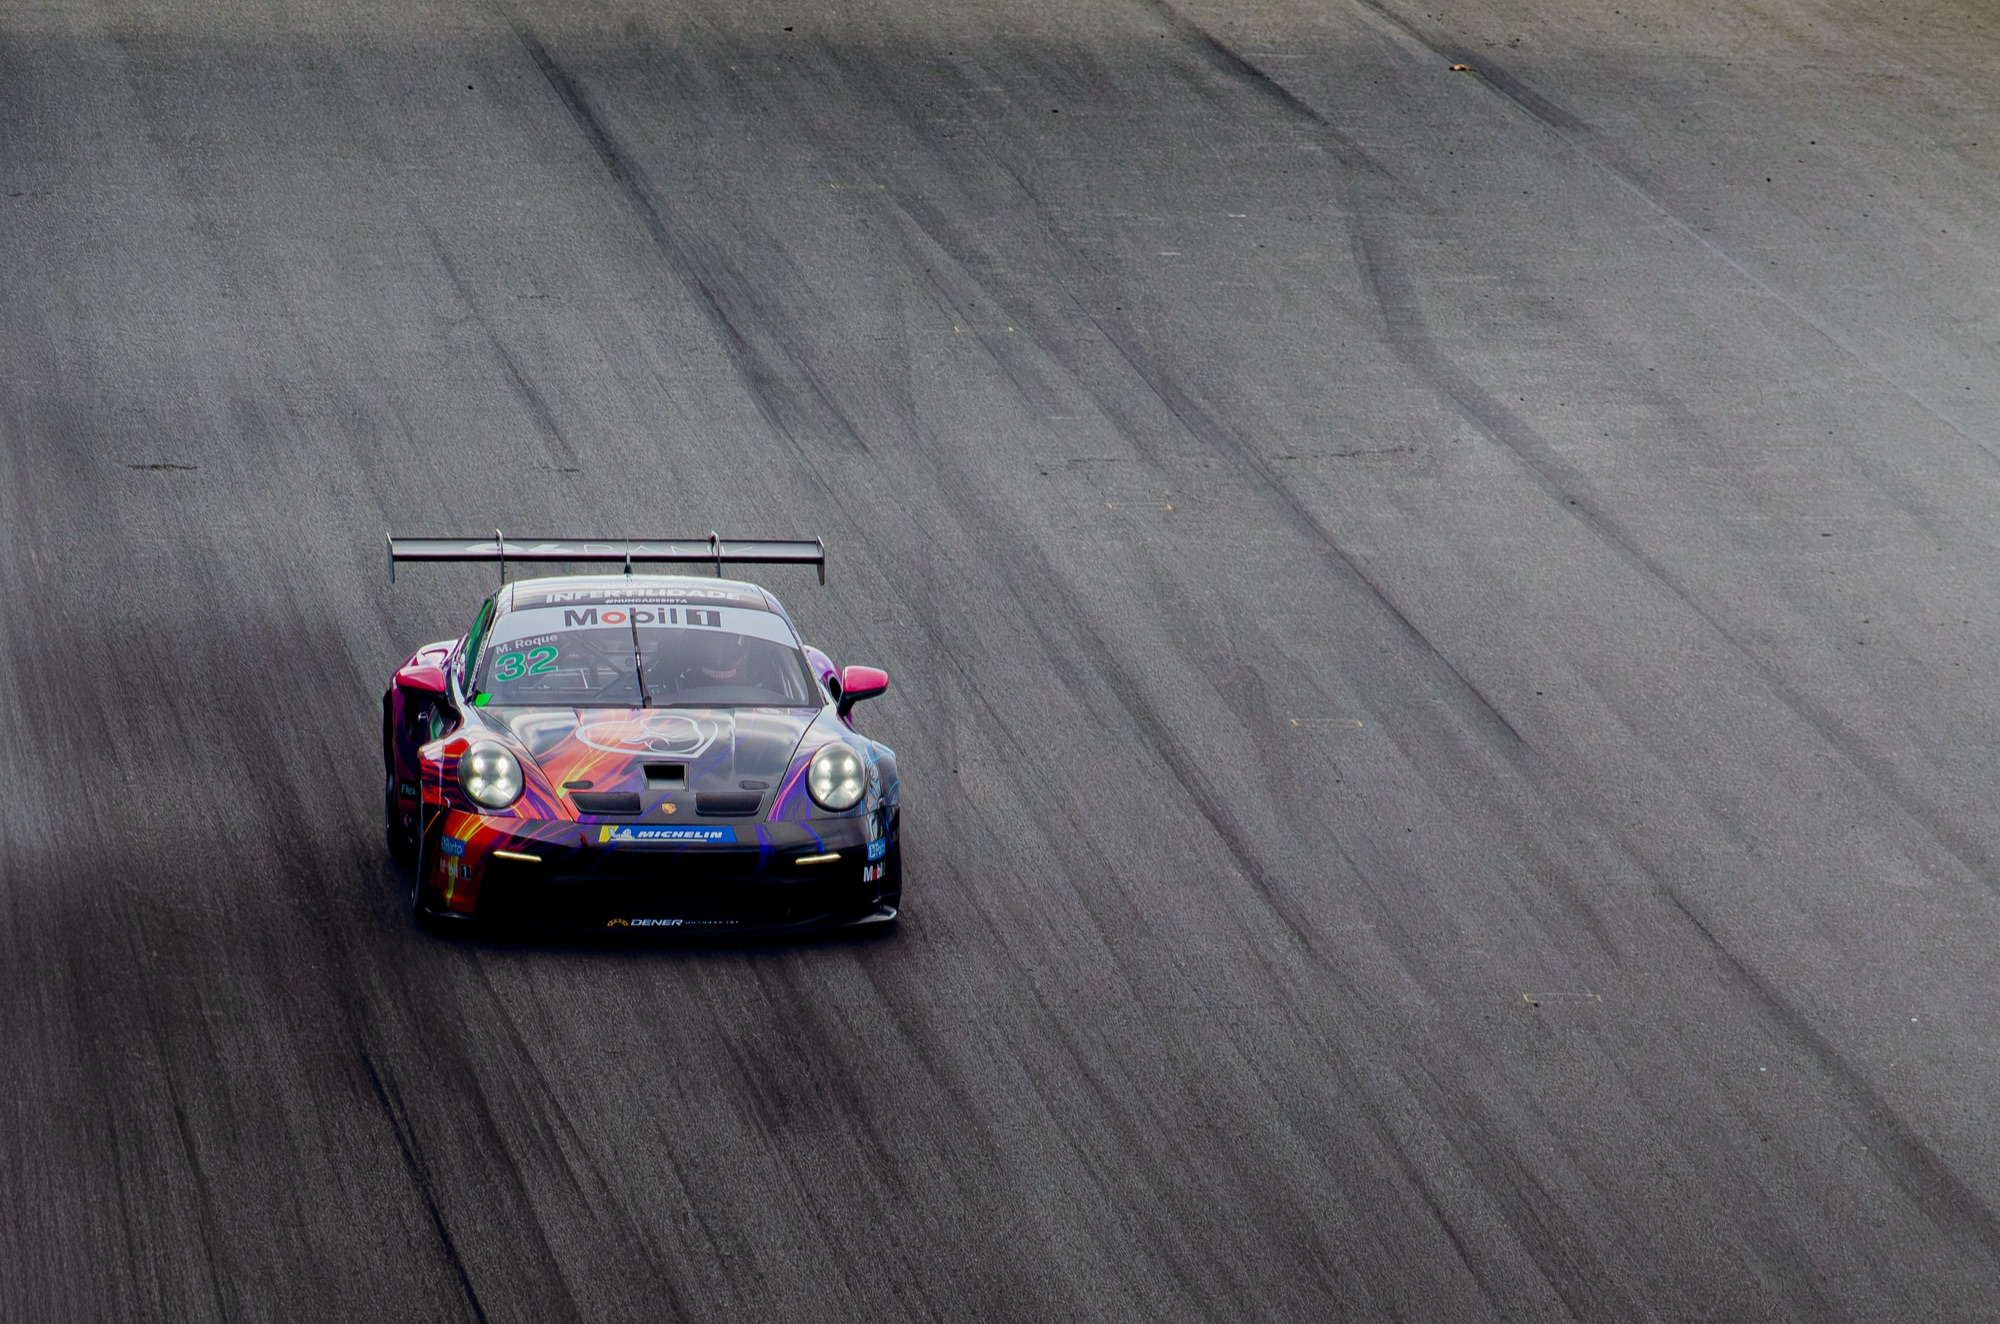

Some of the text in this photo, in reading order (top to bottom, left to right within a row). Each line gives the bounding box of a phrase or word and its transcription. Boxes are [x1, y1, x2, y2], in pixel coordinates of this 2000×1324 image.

[545, 589, 741, 603] INFERTILIDADE
[564, 607, 678, 627] Mobil
[496, 635, 558, 655] M. Roque
[495, 646, 558, 682] 32
[630, 919, 683, 927] DENER
